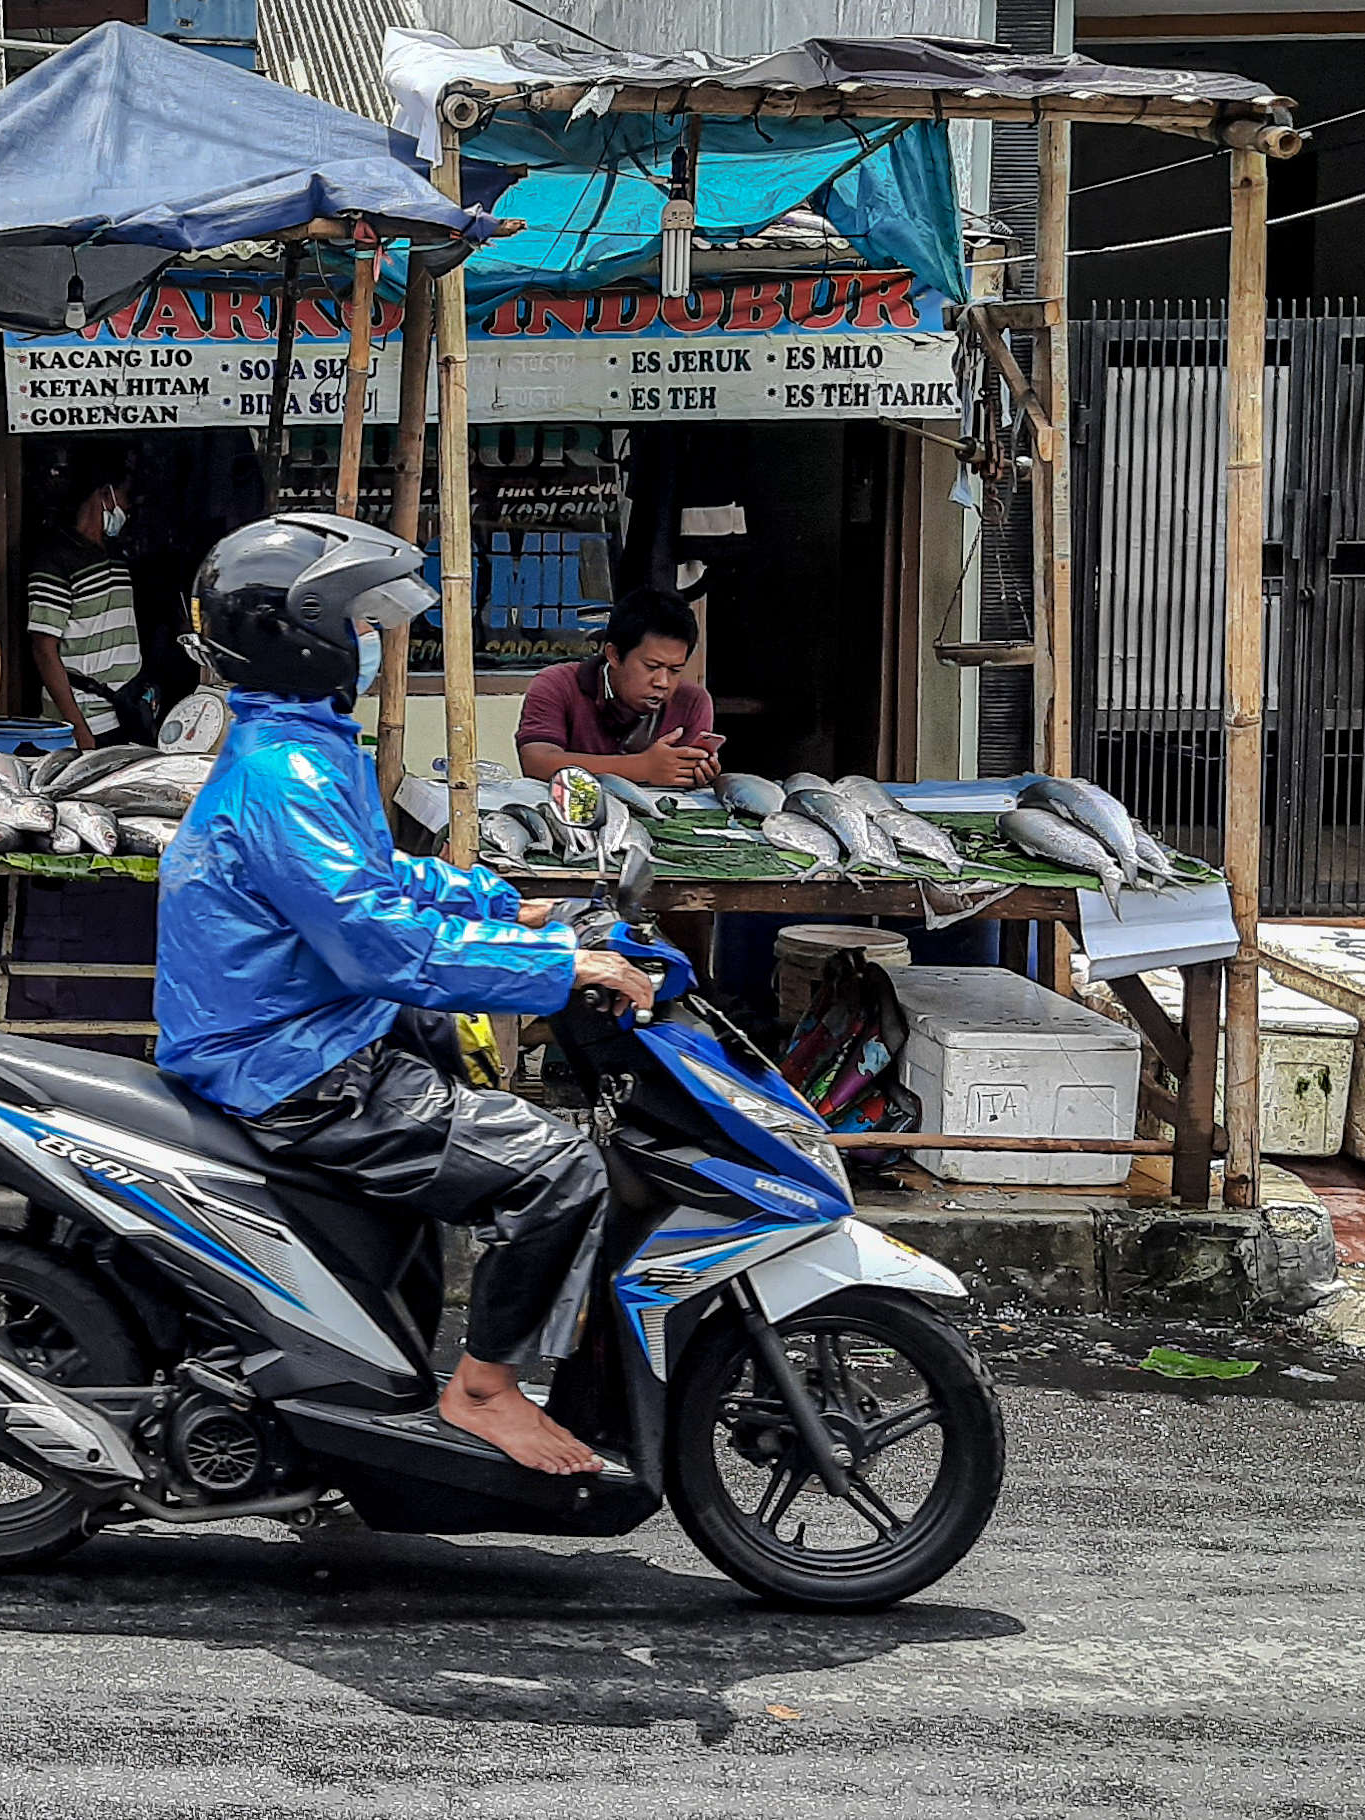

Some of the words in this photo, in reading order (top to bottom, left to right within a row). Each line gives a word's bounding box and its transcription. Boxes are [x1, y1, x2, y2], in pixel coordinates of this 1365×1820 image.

[77, 287, 405, 340] WARKO
[488, 270, 920, 336] INDOBUR
[28, 350, 141, 371] KACANG
[150, 349, 193, 368] IJO
[239, 359, 307, 380] SOA
[313, 358, 378, 380] SUU
[630, 351, 660, 374] ES
[668, 349, 751, 374] JERUK
[785, 347, 816, 370] ES
[823, 345, 884, 369] MILO
[29, 379, 118, 399] KETAN
[127, 378, 209, 396] HITAM
[630, 388, 660, 410] ES
[668, 386, 717, 410] TEH
[785, 385, 816, 408] ES
[823, 383, 872, 407] TEH
[878, 382, 954, 407] TARIK
[30, 405, 179, 426] GORENGAN
[239, 393, 303, 415] BIA
[308, 392, 373, 414] SUU
[288, 424, 619, 467] BUUR
[753, 1177, 819, 1210] HONDA
